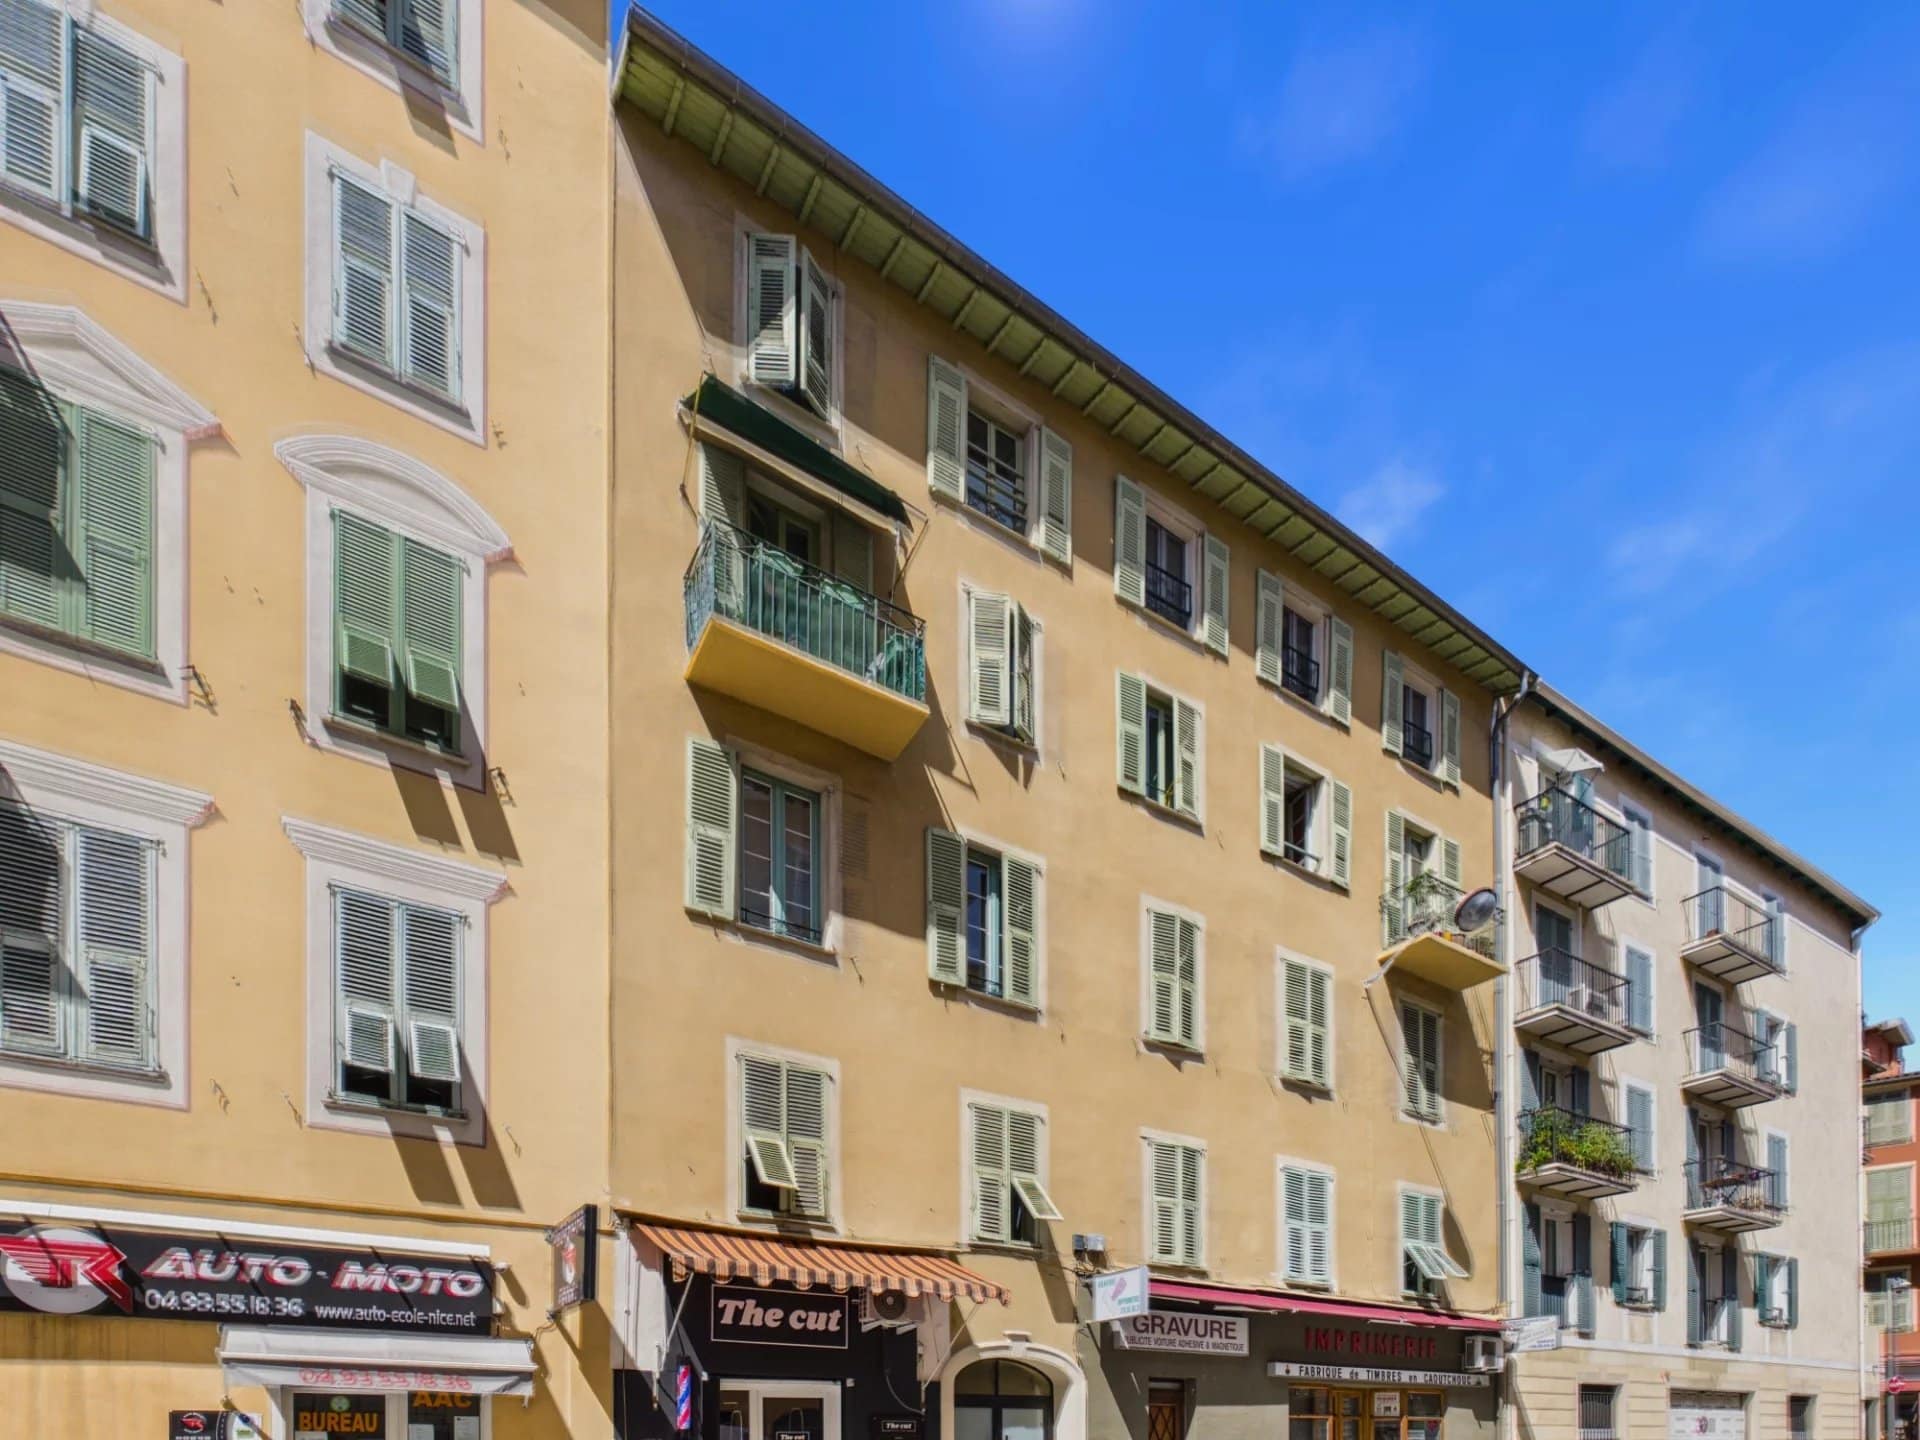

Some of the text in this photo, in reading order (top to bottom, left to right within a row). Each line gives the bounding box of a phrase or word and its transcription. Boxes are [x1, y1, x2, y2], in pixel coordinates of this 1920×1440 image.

[141, 1247, 311, 1287] AUTO
[331, 1260, 485, 1297] MOTO
[315, 1304, 477, 1328] www.auto-ecole-nice.net
[718, 1299, 841, 1333] The cut
[1132, 1315, 1237, 1340] GRAVURE
[1305, 1326, 1437, 1359] IMPRIMERIE
[1299, 1365, 1472, 1386] FABRIQUE de TIMBRES en CAOUTCHOUC
[299, 1411, 379, 1433] BUREAU
